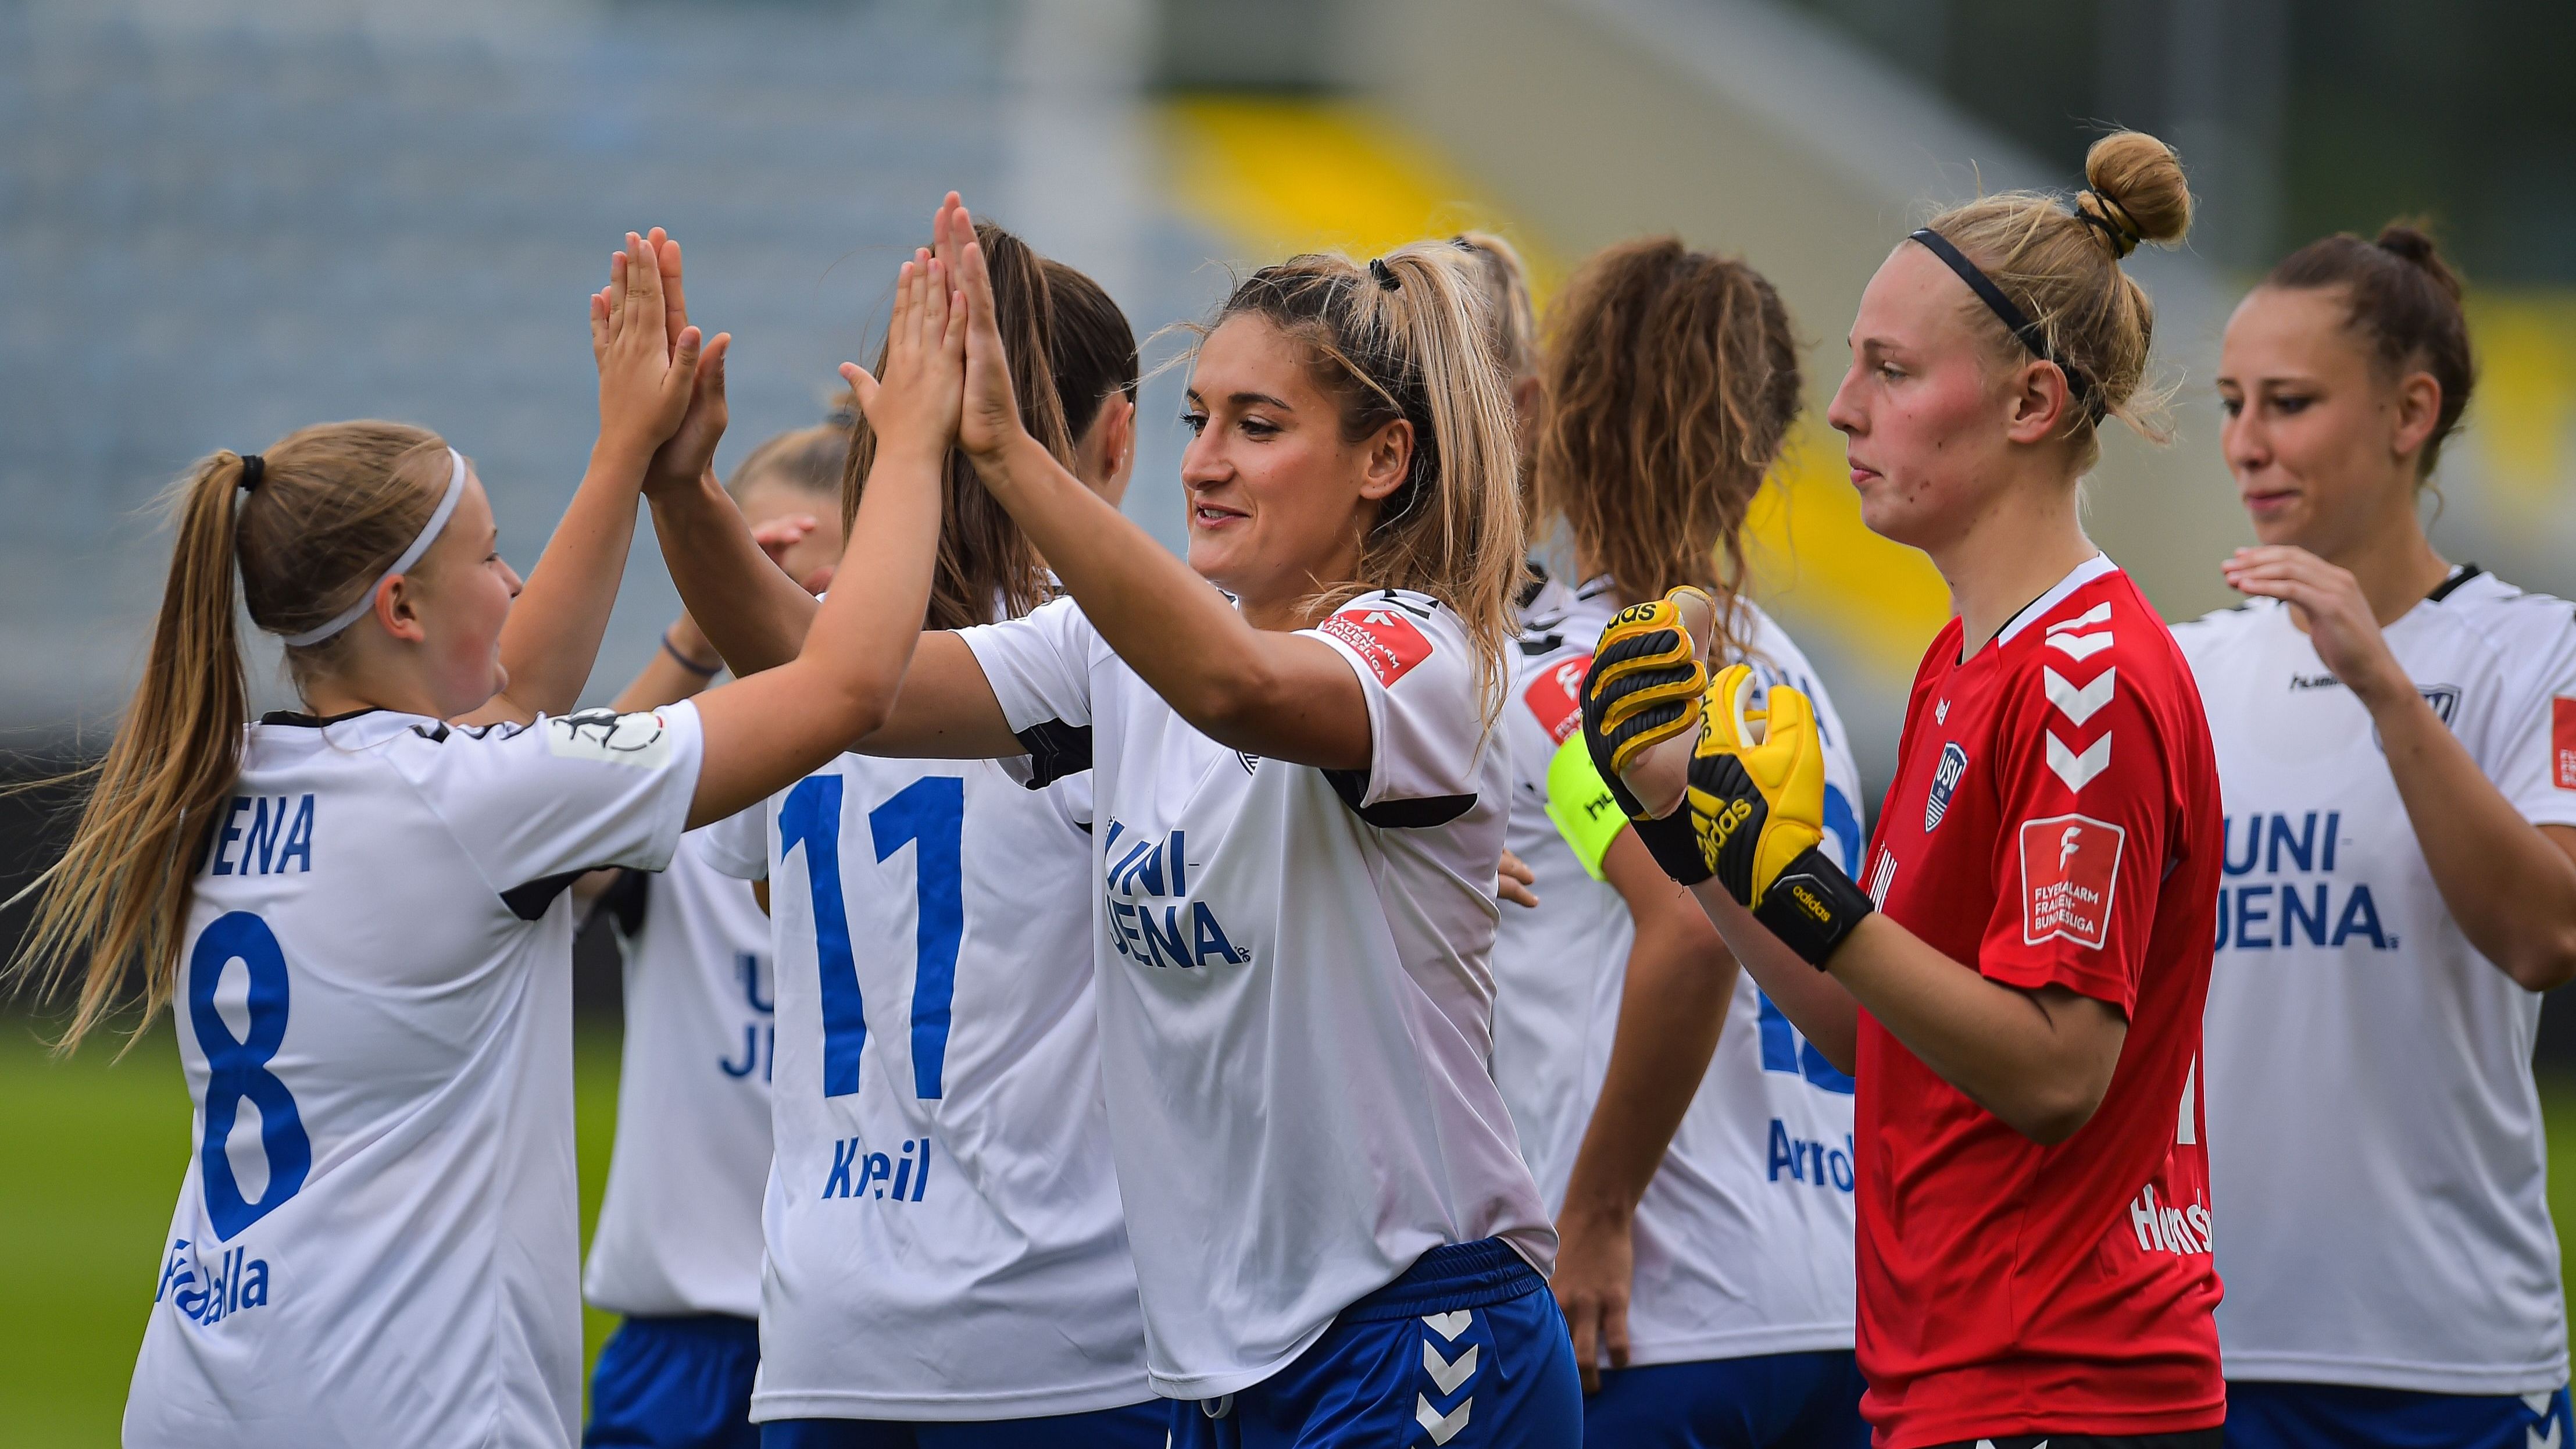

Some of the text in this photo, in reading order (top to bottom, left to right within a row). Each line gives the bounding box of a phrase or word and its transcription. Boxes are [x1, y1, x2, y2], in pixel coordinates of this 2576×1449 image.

[1937, 752, 1963, 791] USV
[1793, 886, 1830, 922] adidas
[2035, 880, 2099, 905] FLYERALARM
[2035, 894, 2075, 916] FRAUEN-
[778, 773, 964, 1098] 11
[2035, 908, 2094, 934] BUNDESLIGA
[188, 910, 312, 1243] 8
